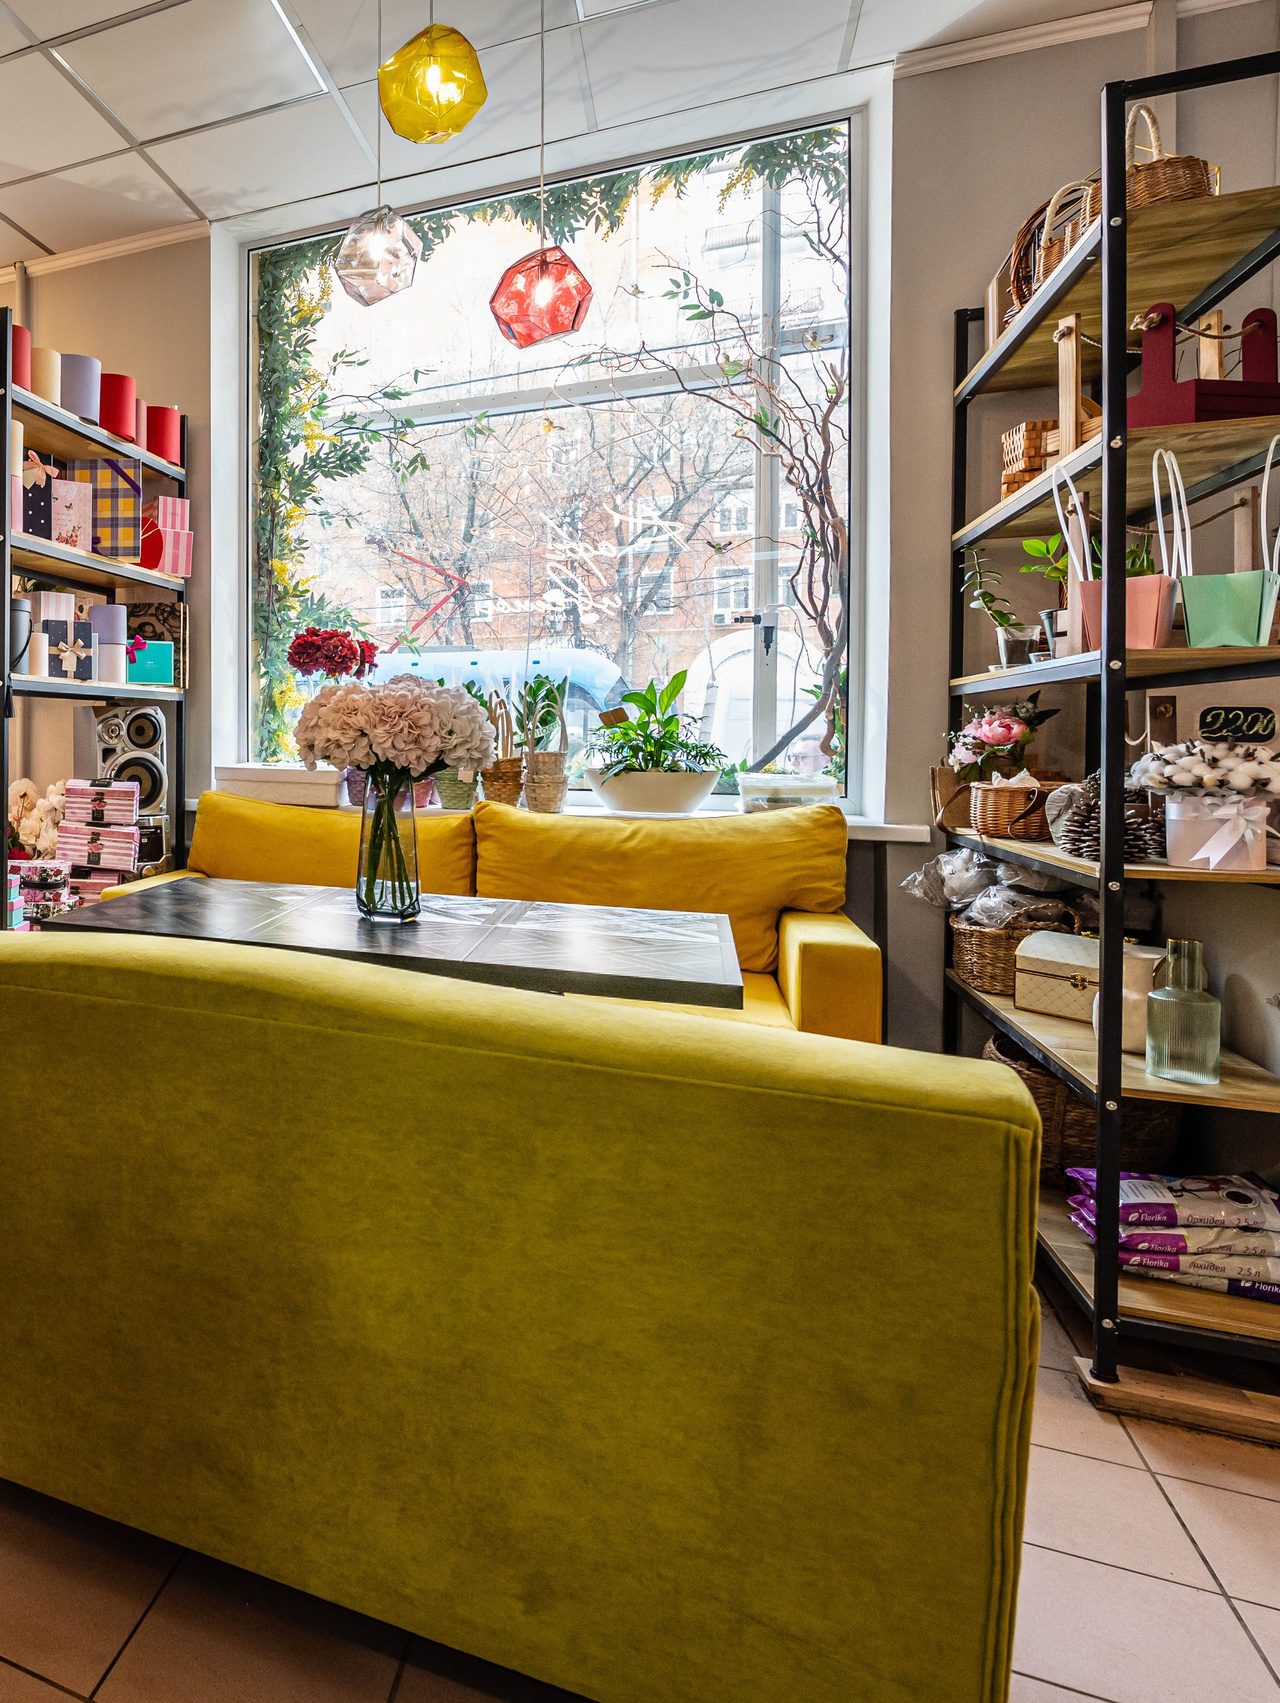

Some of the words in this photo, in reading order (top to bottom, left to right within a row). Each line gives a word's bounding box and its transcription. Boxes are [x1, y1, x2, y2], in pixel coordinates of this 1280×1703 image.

[1200, 709, 1275, 737] 2200
[1140, 1213, 1167, 1222] Florika
[1186, 1214, 1226, 1225] Орхидея
[1150, 1243, 1177, 1253] Florika
[1142, 1257, 1169, 1268] Florika
[1188, 1260, 1226, 1274] Орхидея
[1236, 1266, 1252, 1278] 2,5
